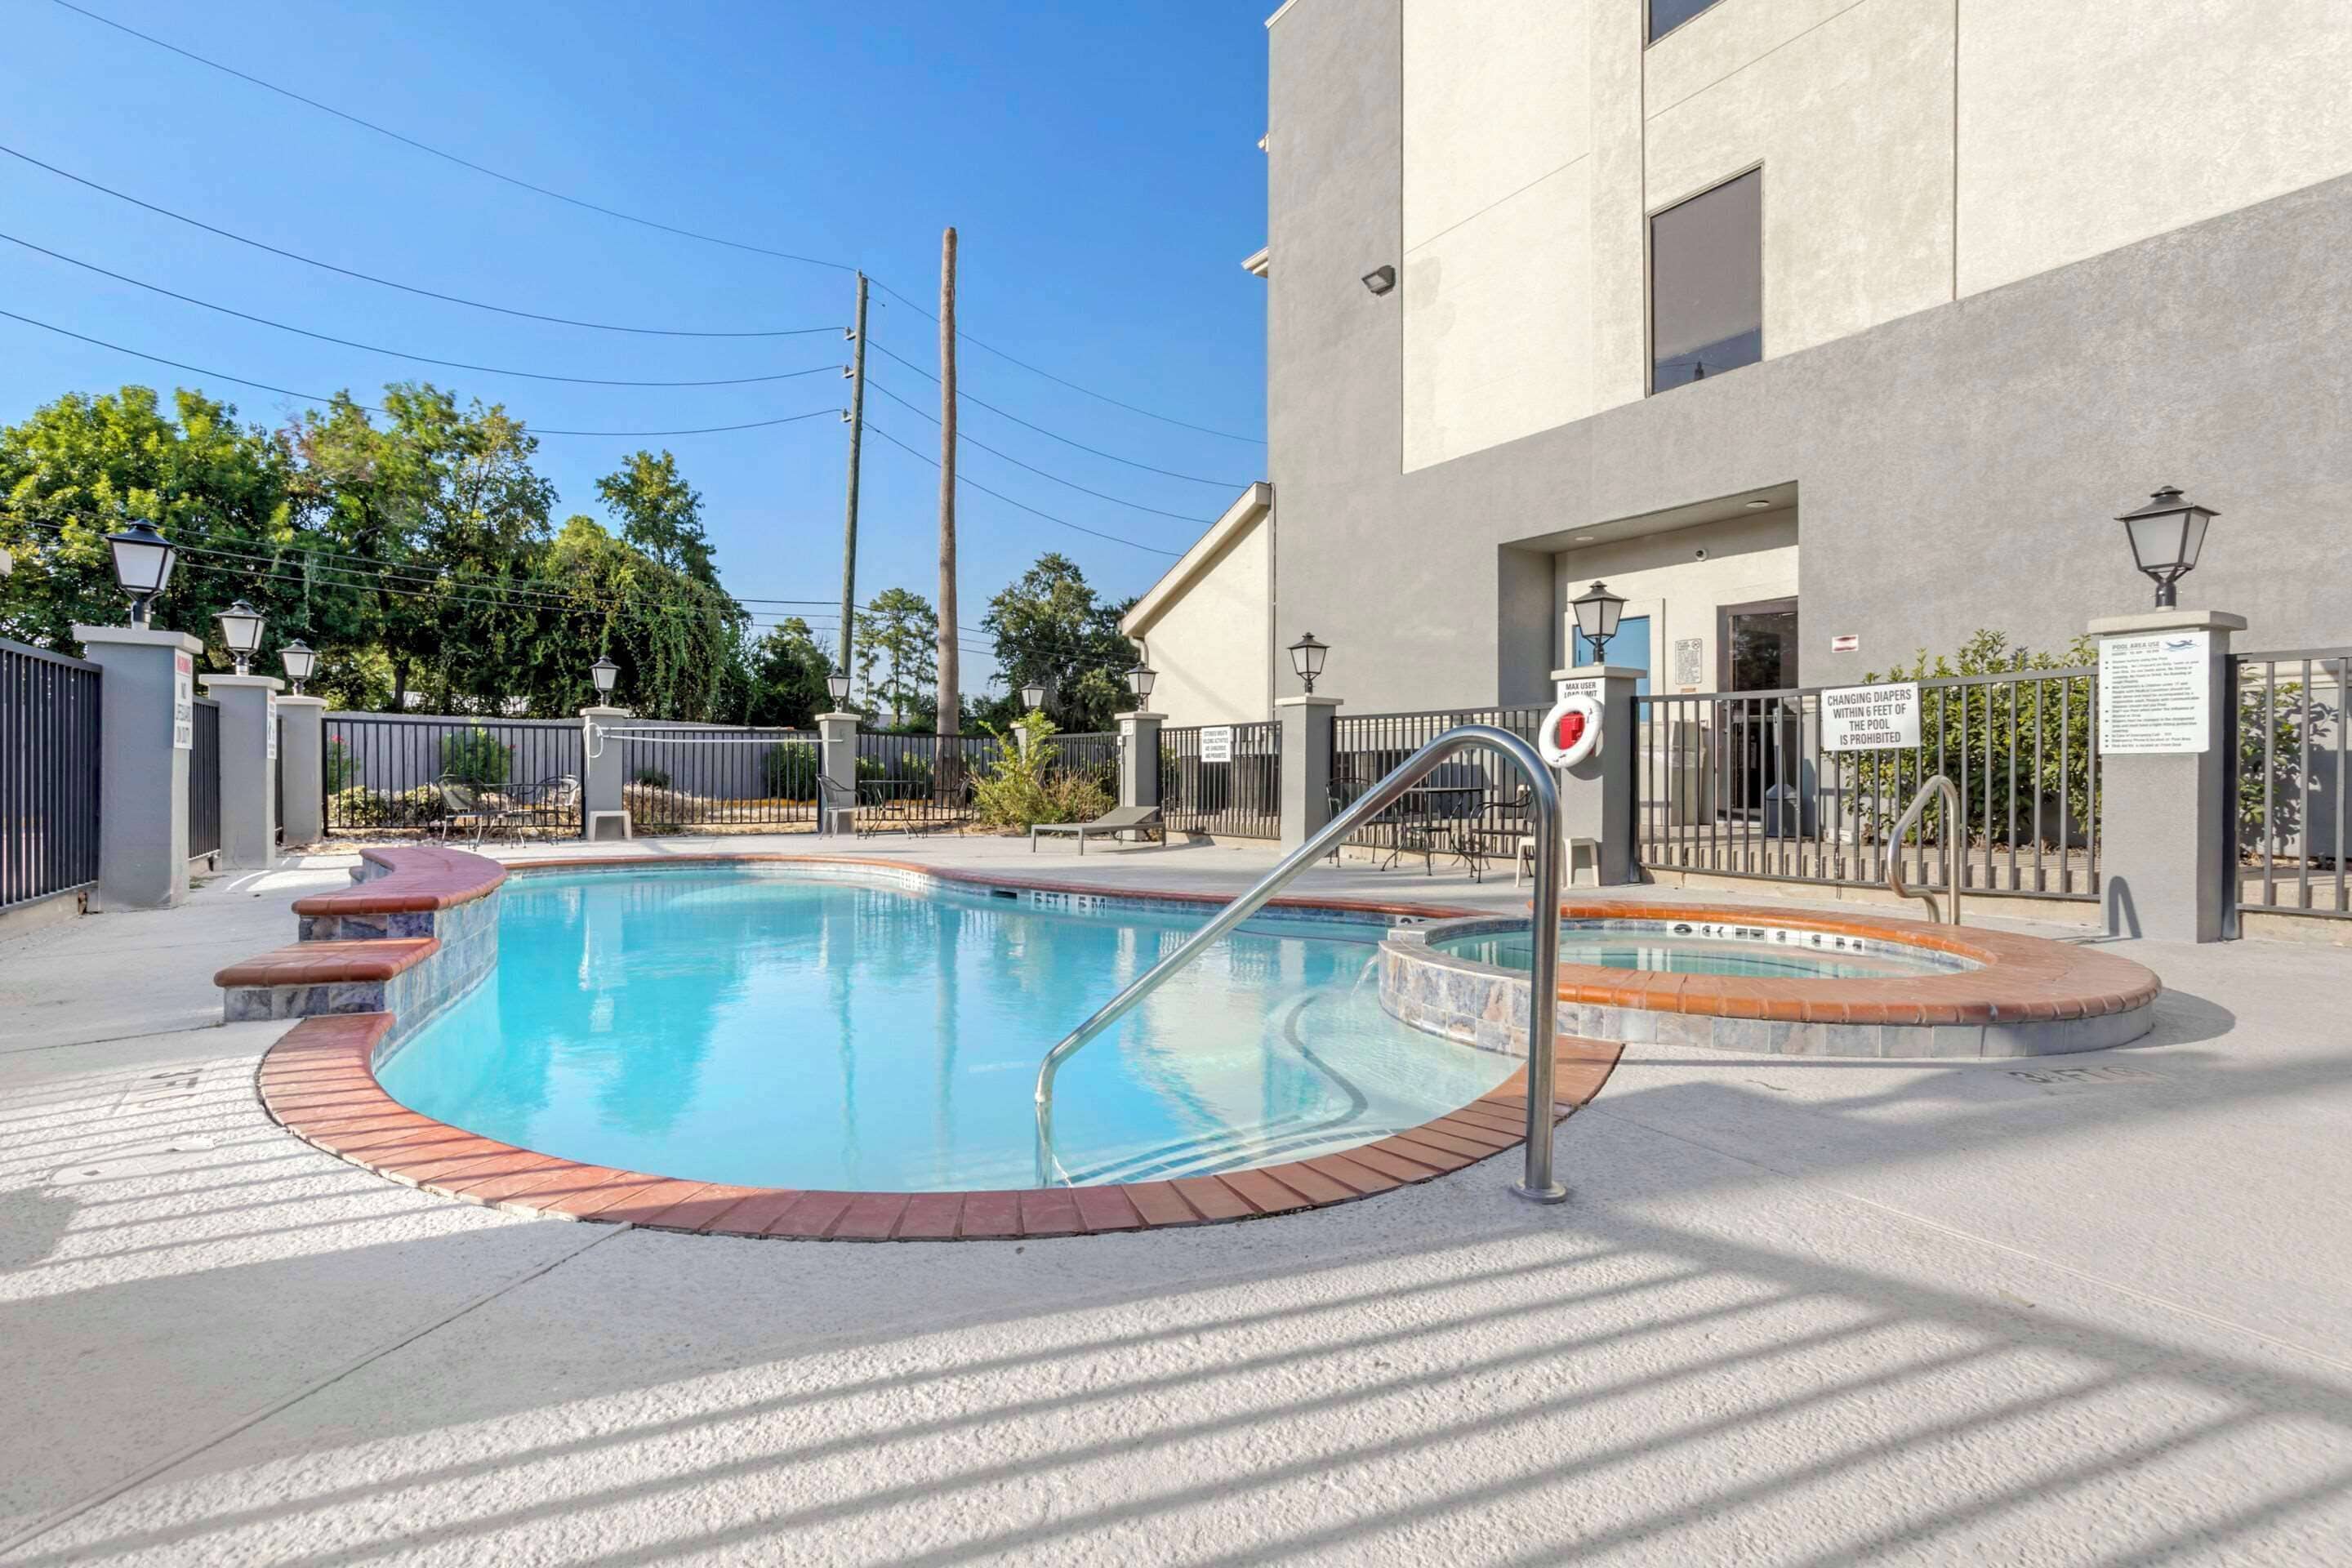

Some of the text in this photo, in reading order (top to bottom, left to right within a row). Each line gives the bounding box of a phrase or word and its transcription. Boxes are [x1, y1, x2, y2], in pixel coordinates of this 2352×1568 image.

[1828, 689, 1912, 706] CHANGING DIAPERS
[1833, 703, 1906, 719] WITHIN 6 FEET OF
[1849, 719, 1890, 731] THE POOL
[1840, 732, 1901, 745] IS PROHIBITED
